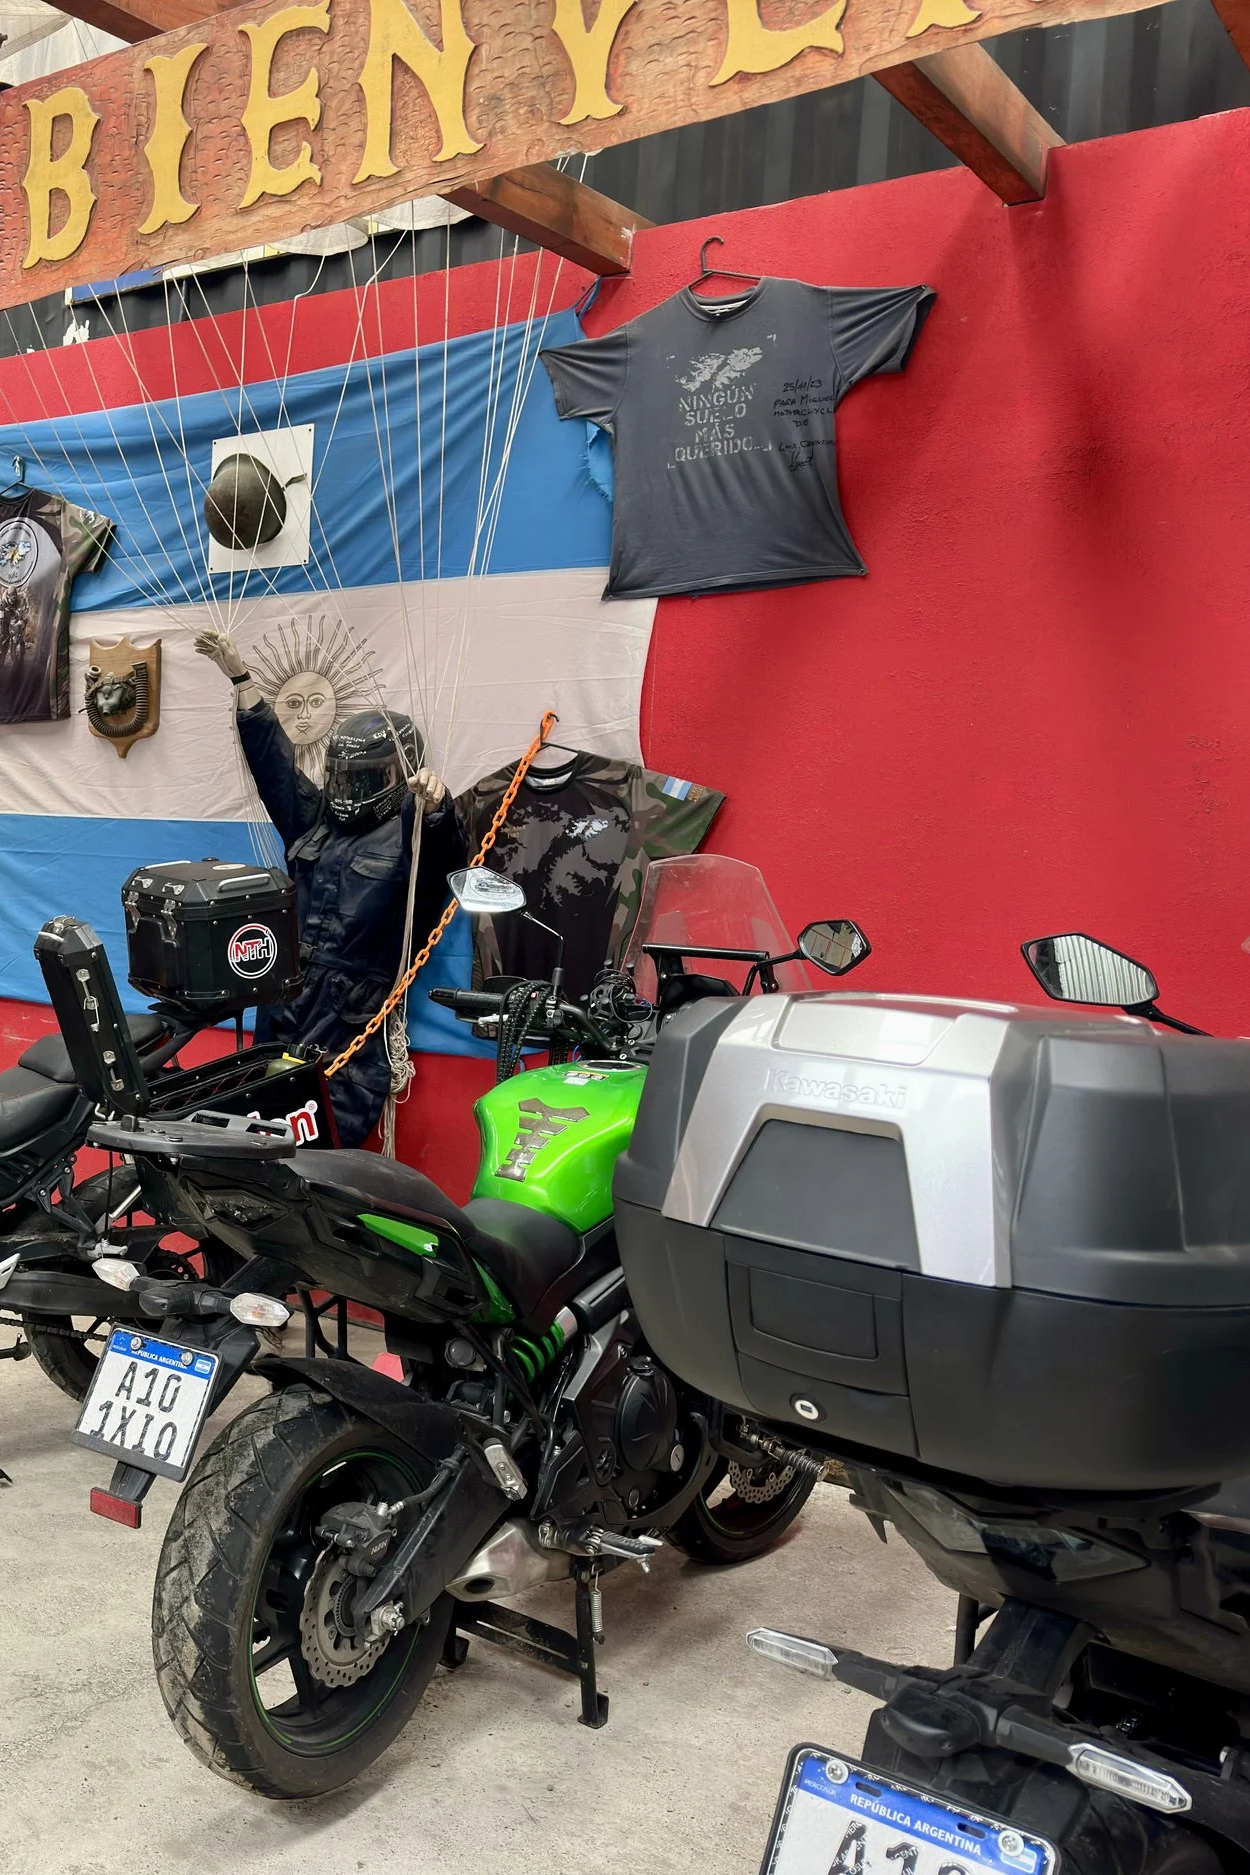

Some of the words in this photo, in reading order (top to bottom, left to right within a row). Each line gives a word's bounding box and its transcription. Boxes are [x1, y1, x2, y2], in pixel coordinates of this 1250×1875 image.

[695, 422, 735, 443] MÁS
[234, 937, 271, 962] NTH
[764, 1068, 908, 1110] Kawasaki
[115, 1361, 183, 1413] A10
[803, 1777, 837, 1797] MERCOSUR
[850, 1793, 911, 1827] REPÚBLICA
[914, 1818, 982, 1856] ARGENTINA
